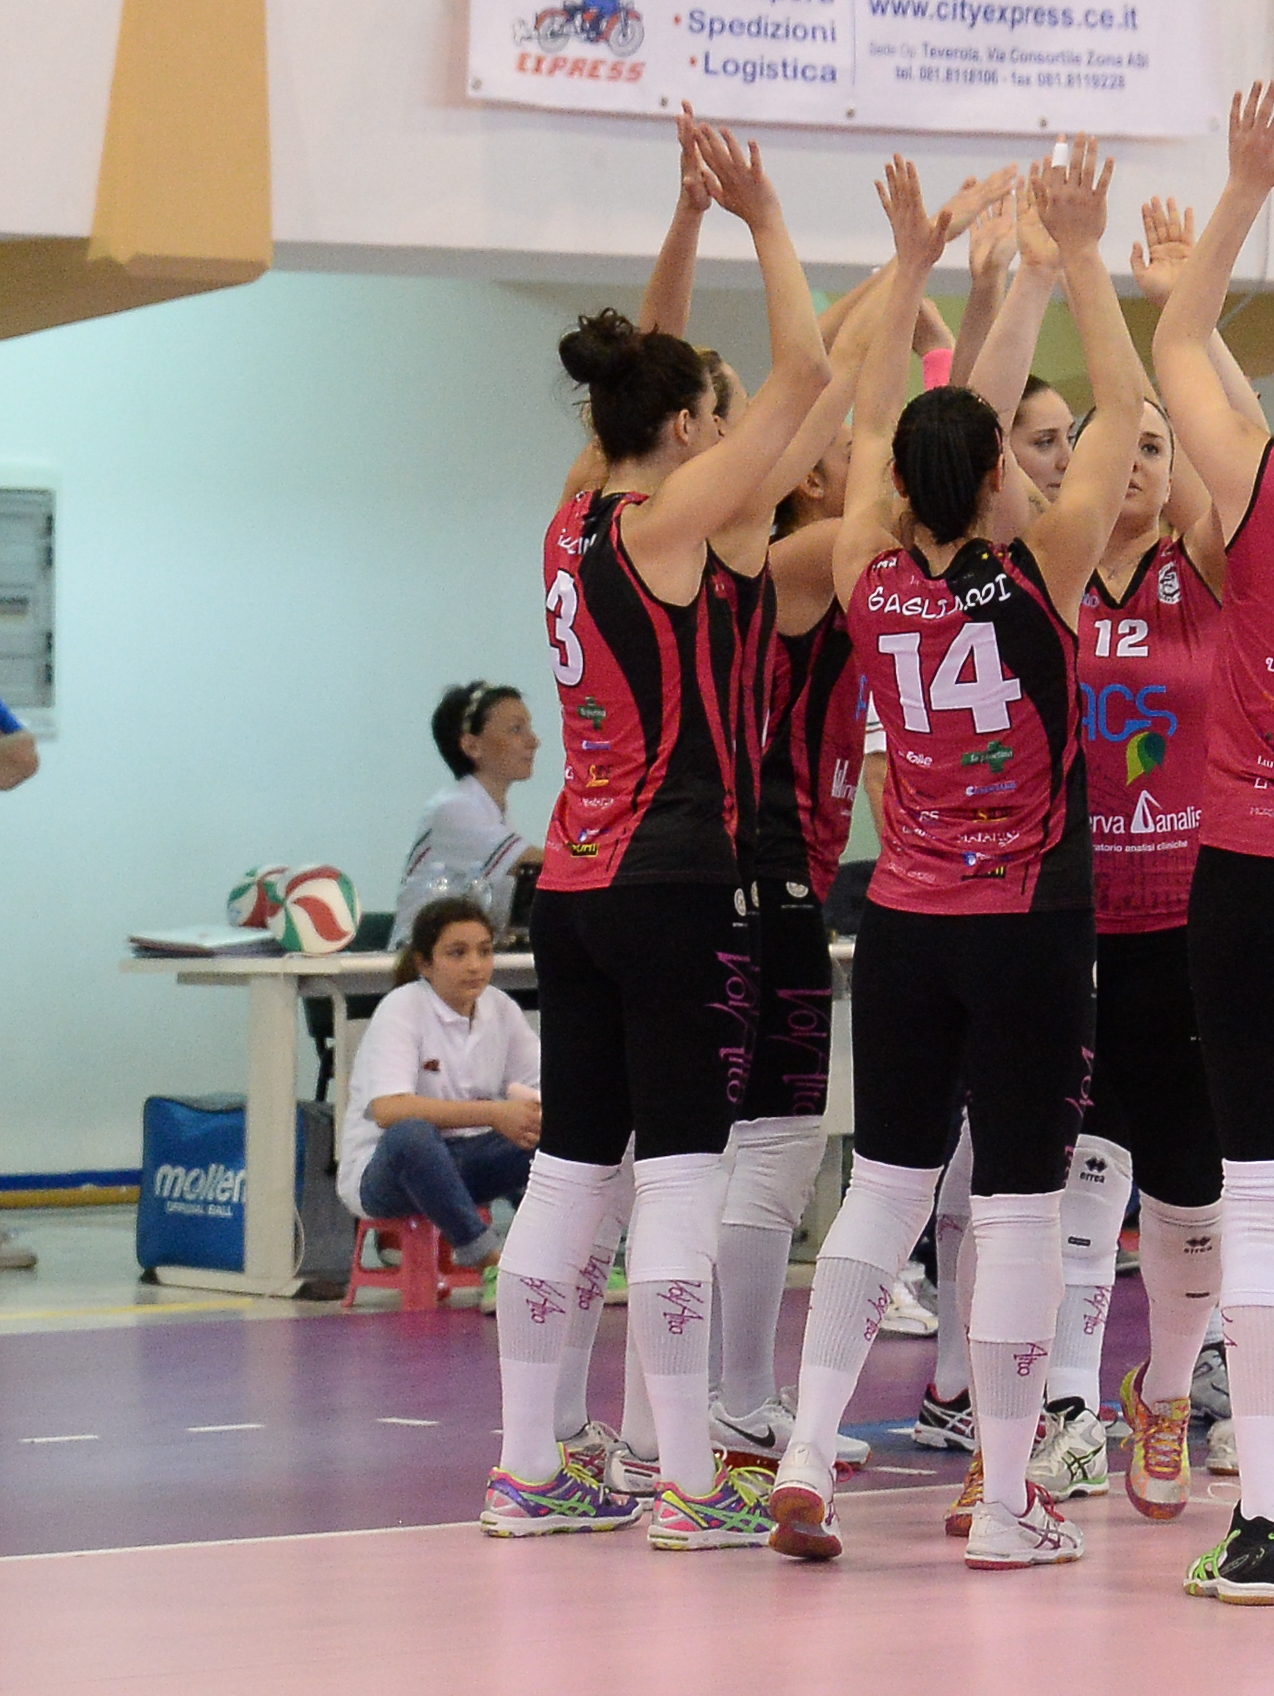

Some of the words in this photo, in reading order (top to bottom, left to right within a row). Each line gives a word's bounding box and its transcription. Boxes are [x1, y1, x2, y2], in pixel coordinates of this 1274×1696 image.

[688, 9, 837, 43] Spedizioni
[703, 51, 837, 84] Logistica
[546, 569, 585, 687] 3
[1094, 618, 1150, 658] 12
[878, 621, 1023, 735] 14
[1080, 1172, 1105, 1183] errea
